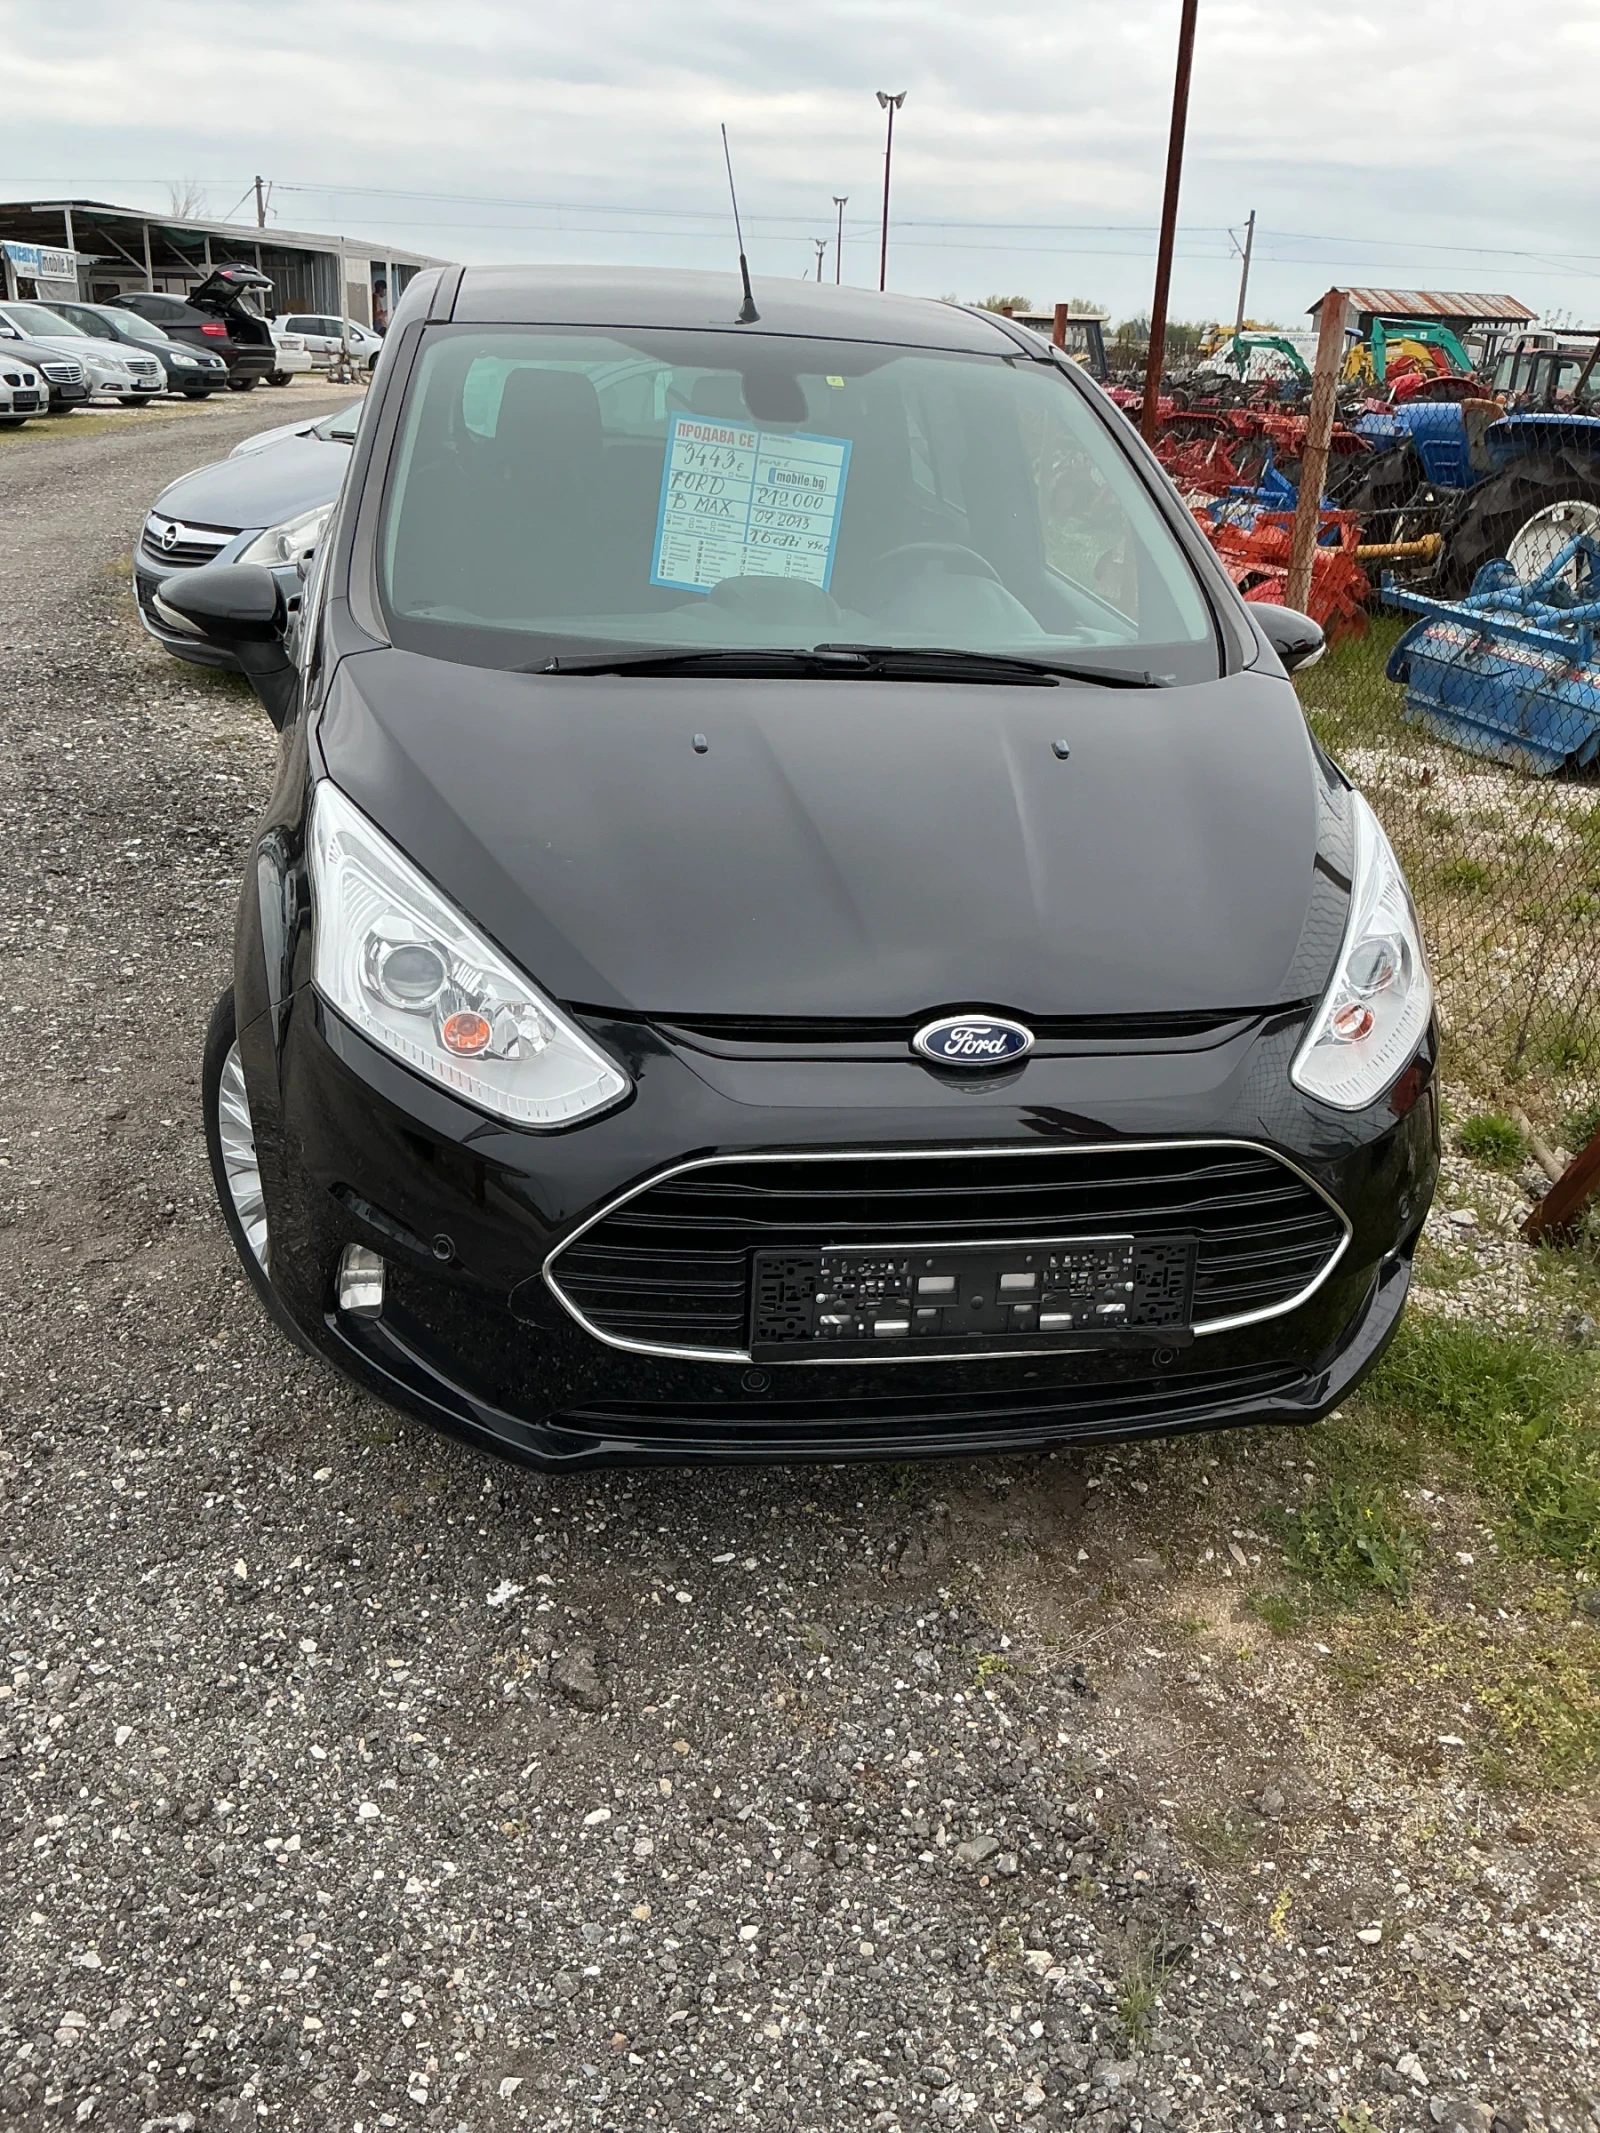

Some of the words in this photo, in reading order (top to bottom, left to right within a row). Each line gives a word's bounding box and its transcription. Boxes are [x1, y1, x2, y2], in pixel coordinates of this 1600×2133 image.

[677, 423, 735, 445] ПРОДАВА
[738, 433, 755, 448] СЕ
[671, 471, 725, 495] FORD
[776, 472, 824, 491] mobile.bg
[693, 497, 733, 515] MAX
[944, 1027, 1008, 1055] Ford
